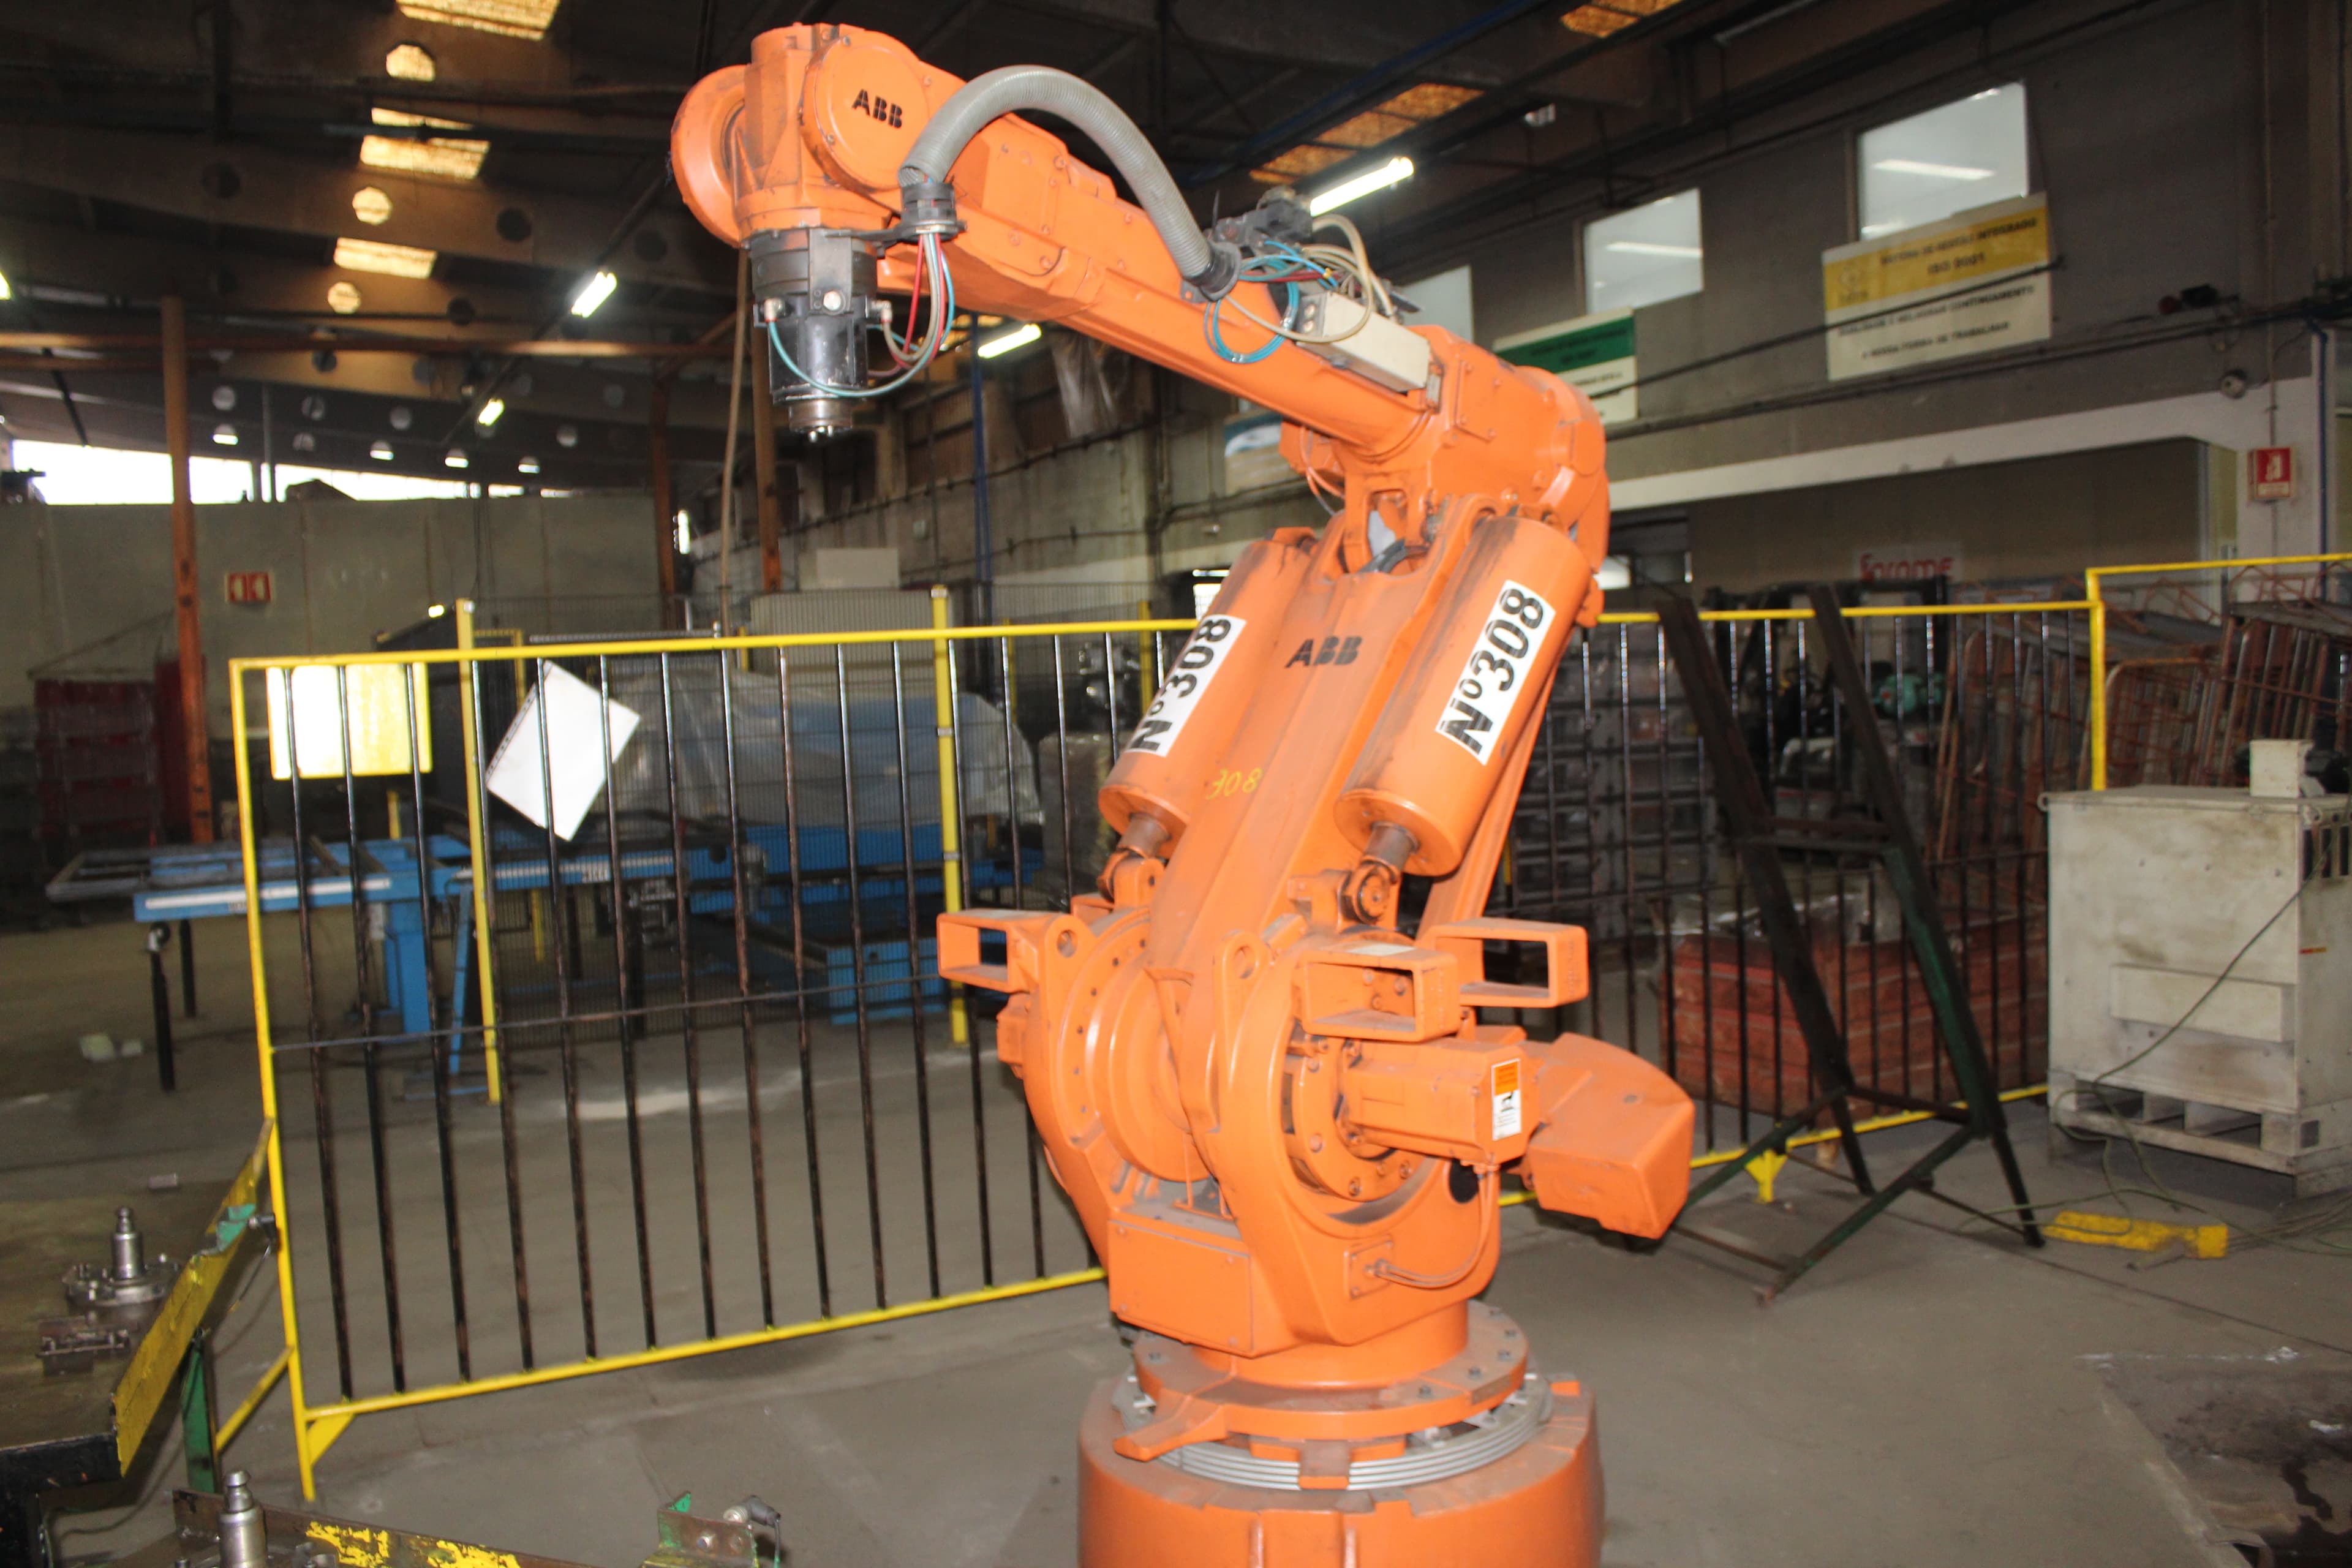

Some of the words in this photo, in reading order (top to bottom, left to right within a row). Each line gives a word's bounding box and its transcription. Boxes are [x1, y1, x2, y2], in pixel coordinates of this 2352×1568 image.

[851, 88, 903, 129] ABB
[1284, 635, 1363, 669] ABB
[1205, 767, 1264, 801] 308
